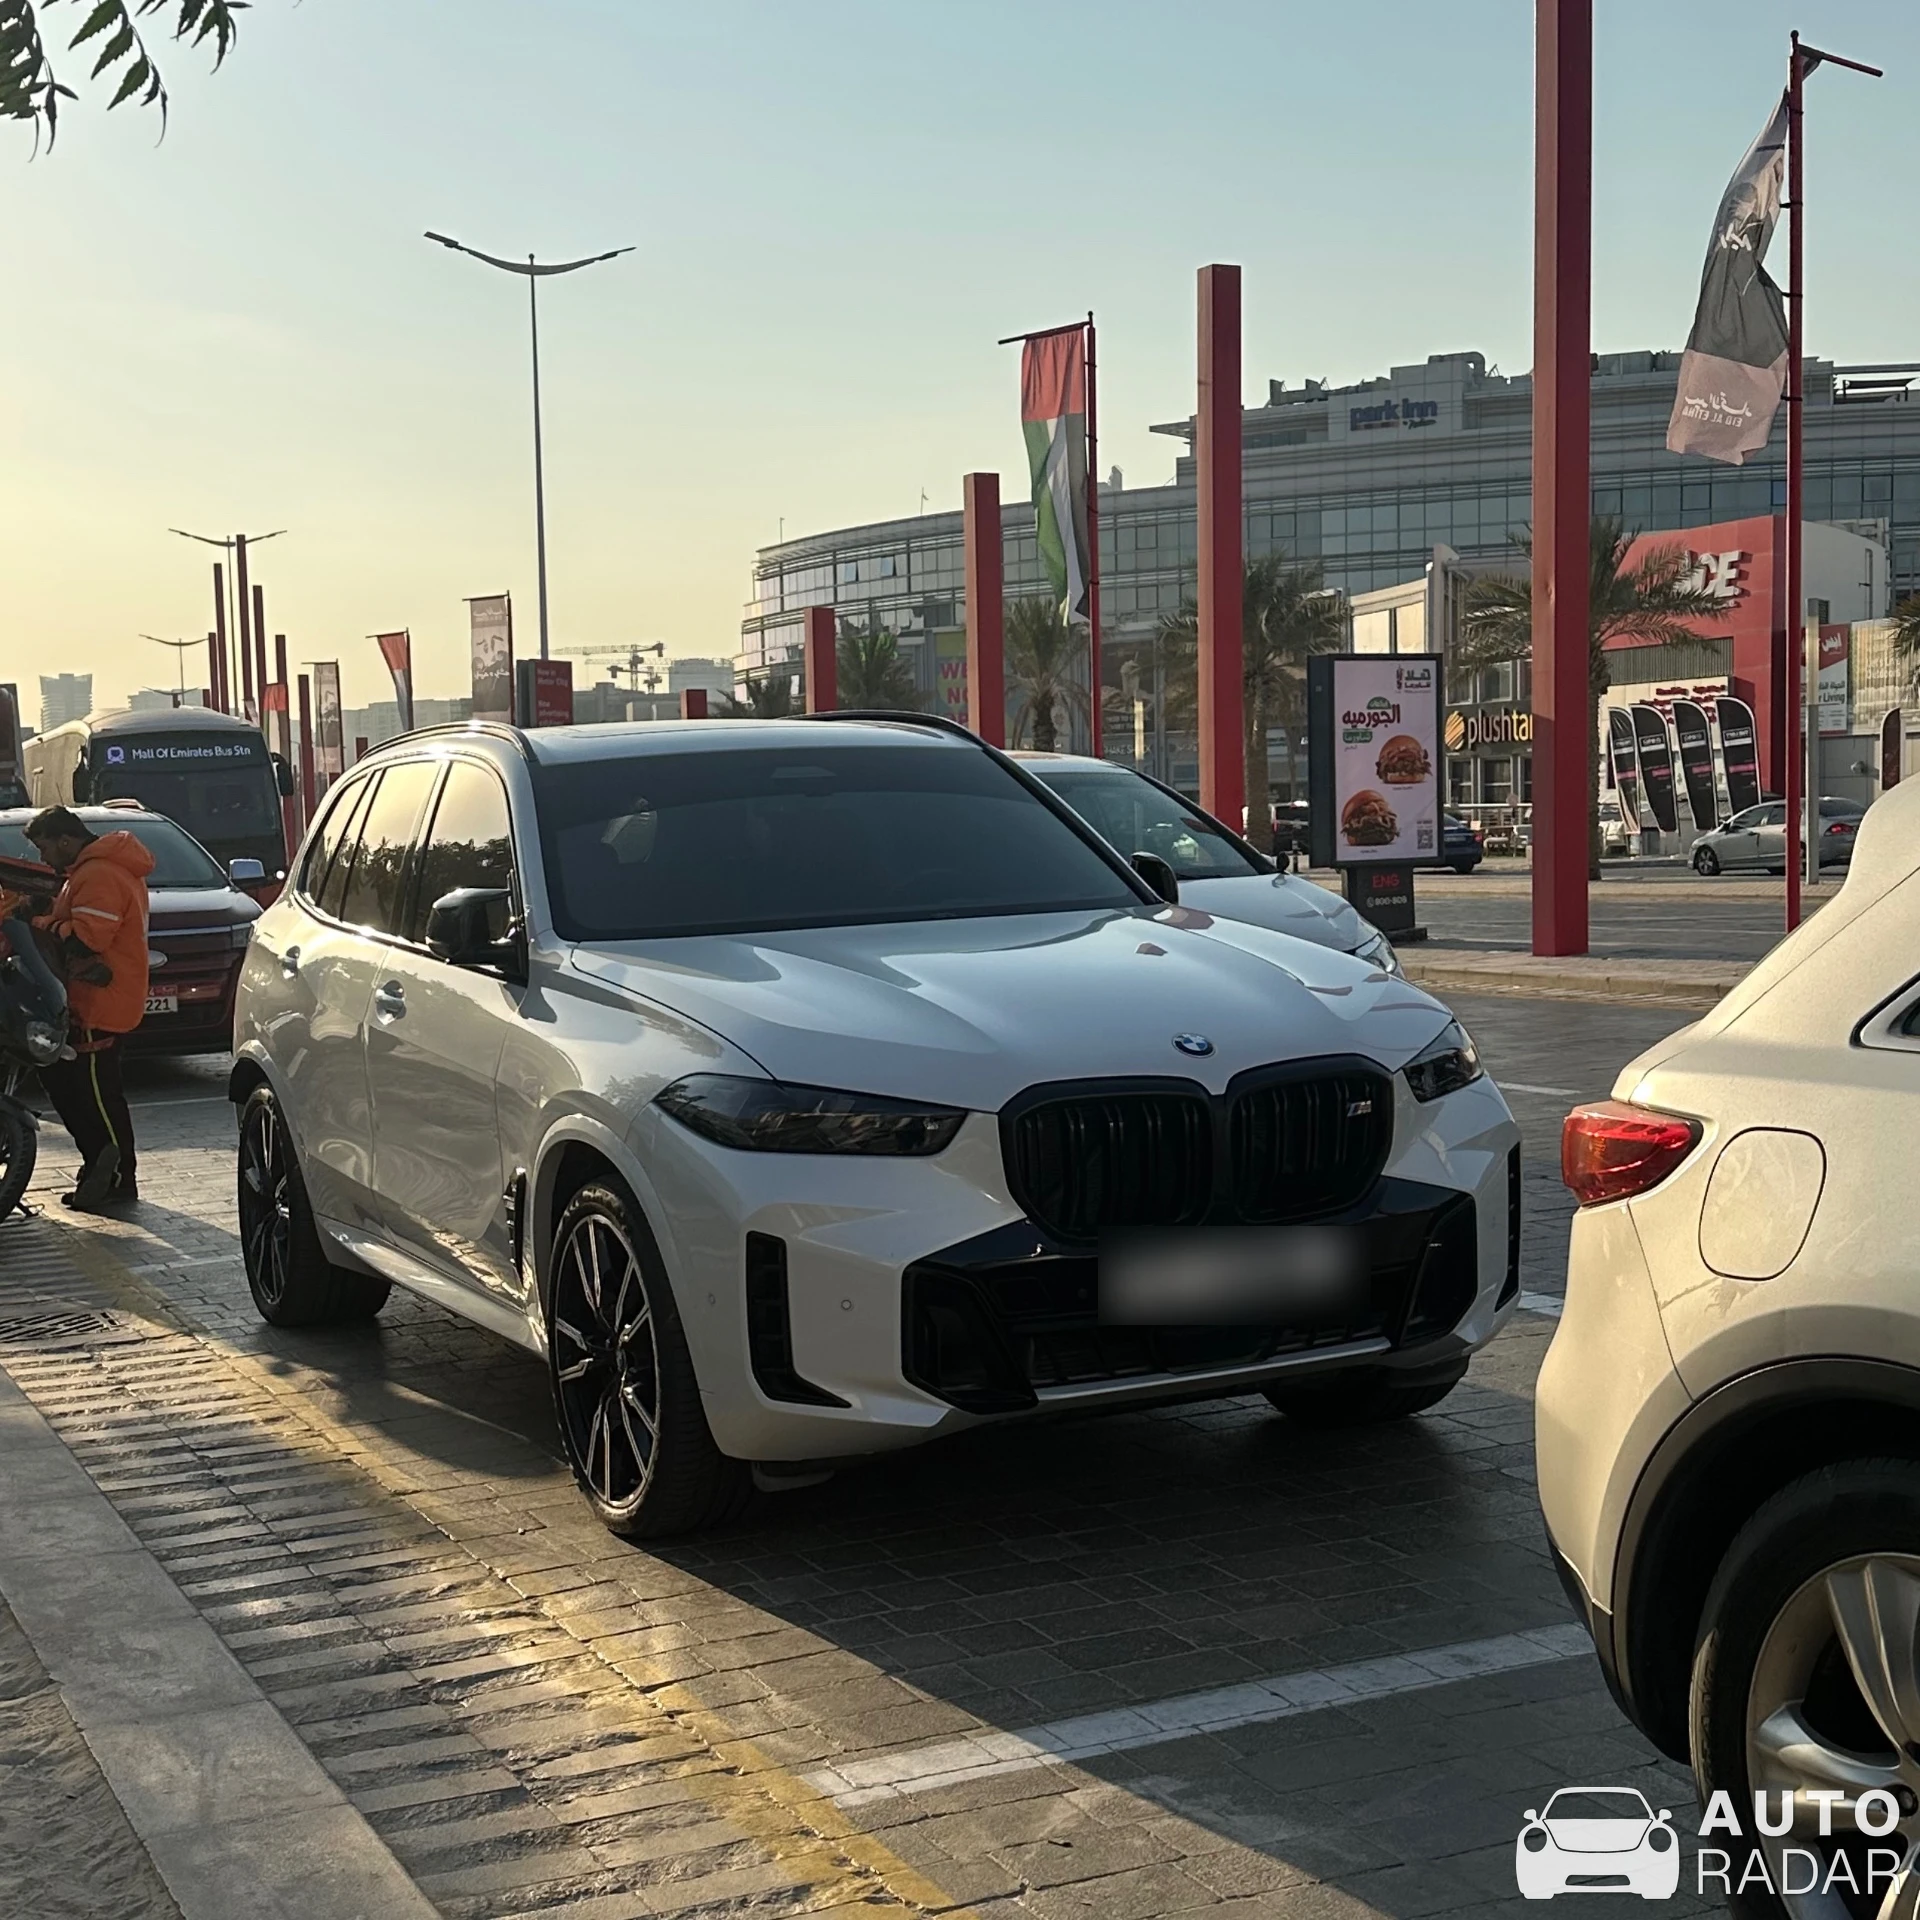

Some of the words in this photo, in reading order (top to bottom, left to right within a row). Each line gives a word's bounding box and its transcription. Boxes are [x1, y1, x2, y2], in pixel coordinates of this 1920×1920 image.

[1350, 400, 1400, 431] park
[1402, 398, 1438, 419] inn
[132, 748, 155, 760] Mall
[156, 747, 169, 758] Of
[170, 746, 214, 758] Emirates
[214, 745, 233, 757] Bus
[233, 744, 251, 756] Stn
[1372, 873, 1400, 888] ENG
[145, 998, 171, 1012] 221
